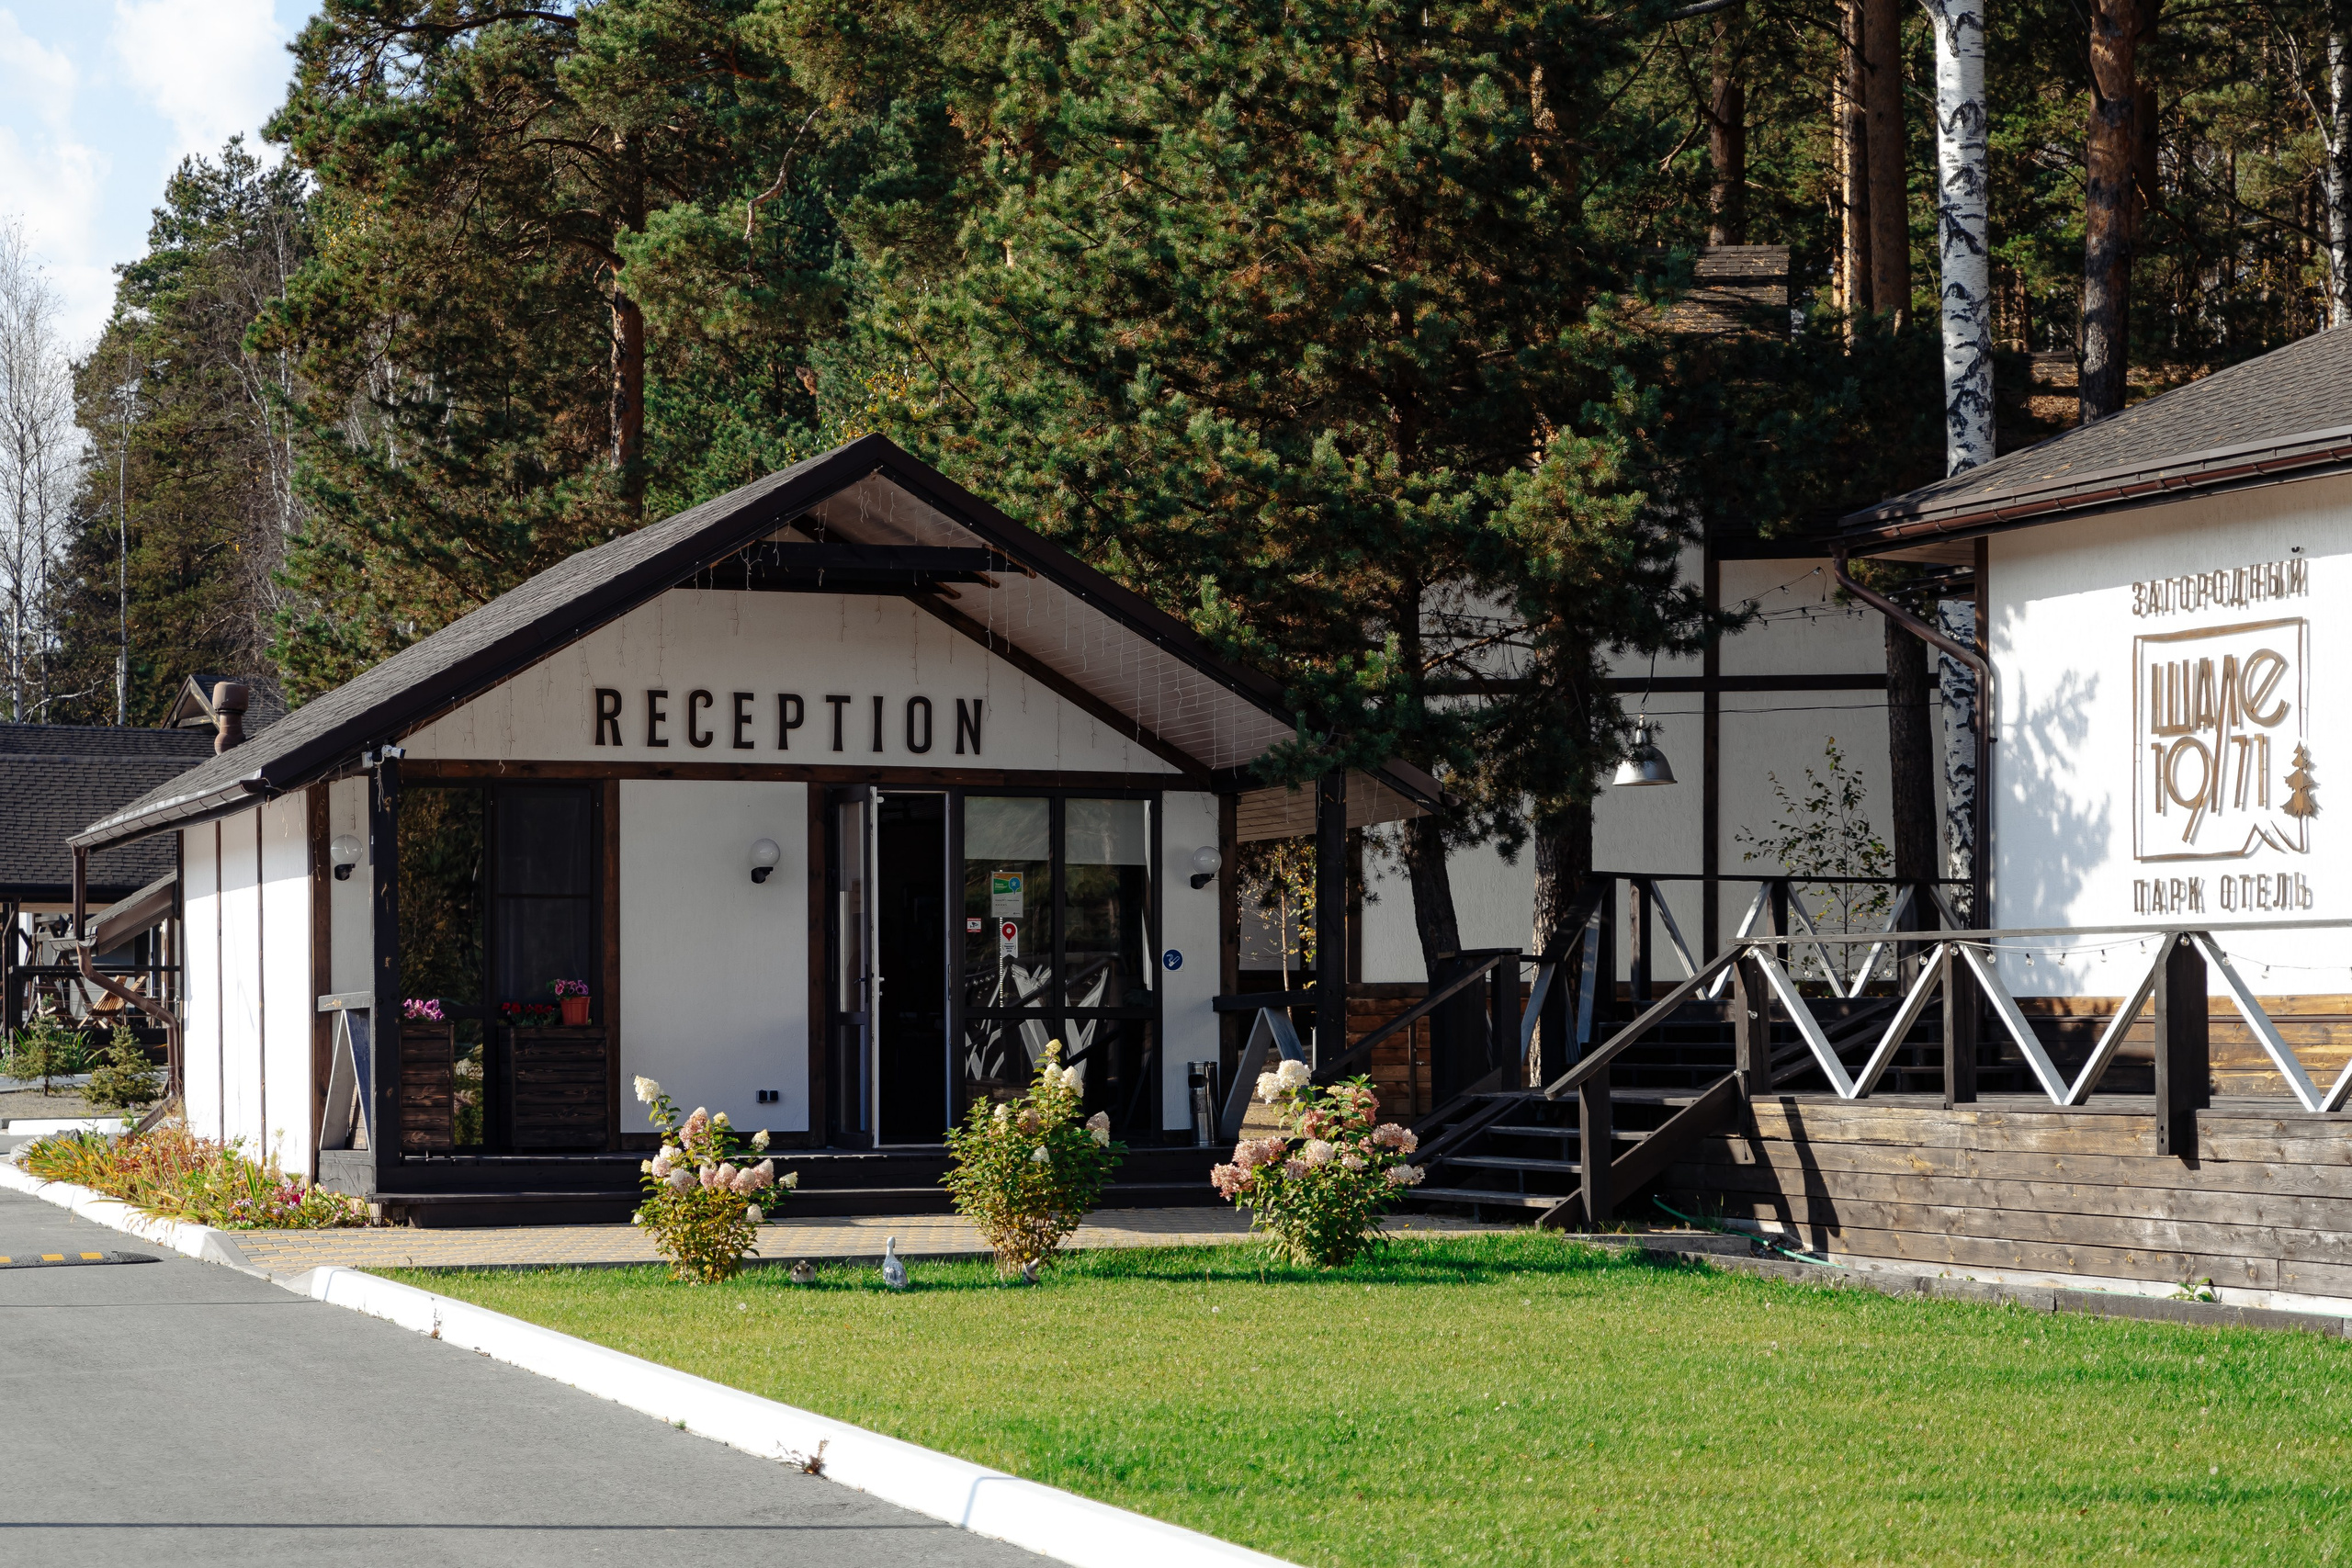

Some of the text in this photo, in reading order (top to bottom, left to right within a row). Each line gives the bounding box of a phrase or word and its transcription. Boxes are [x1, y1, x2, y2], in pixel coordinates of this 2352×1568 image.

[2132, 547, 2303, 615] ЗАГОРОДНЫЙ
[594, 687, 983, 755] RECEPTION
[2150, 733, 2265, 843] 1971
[2133, 872, 2307, 913] ПАРК ОТЕЛЬ
